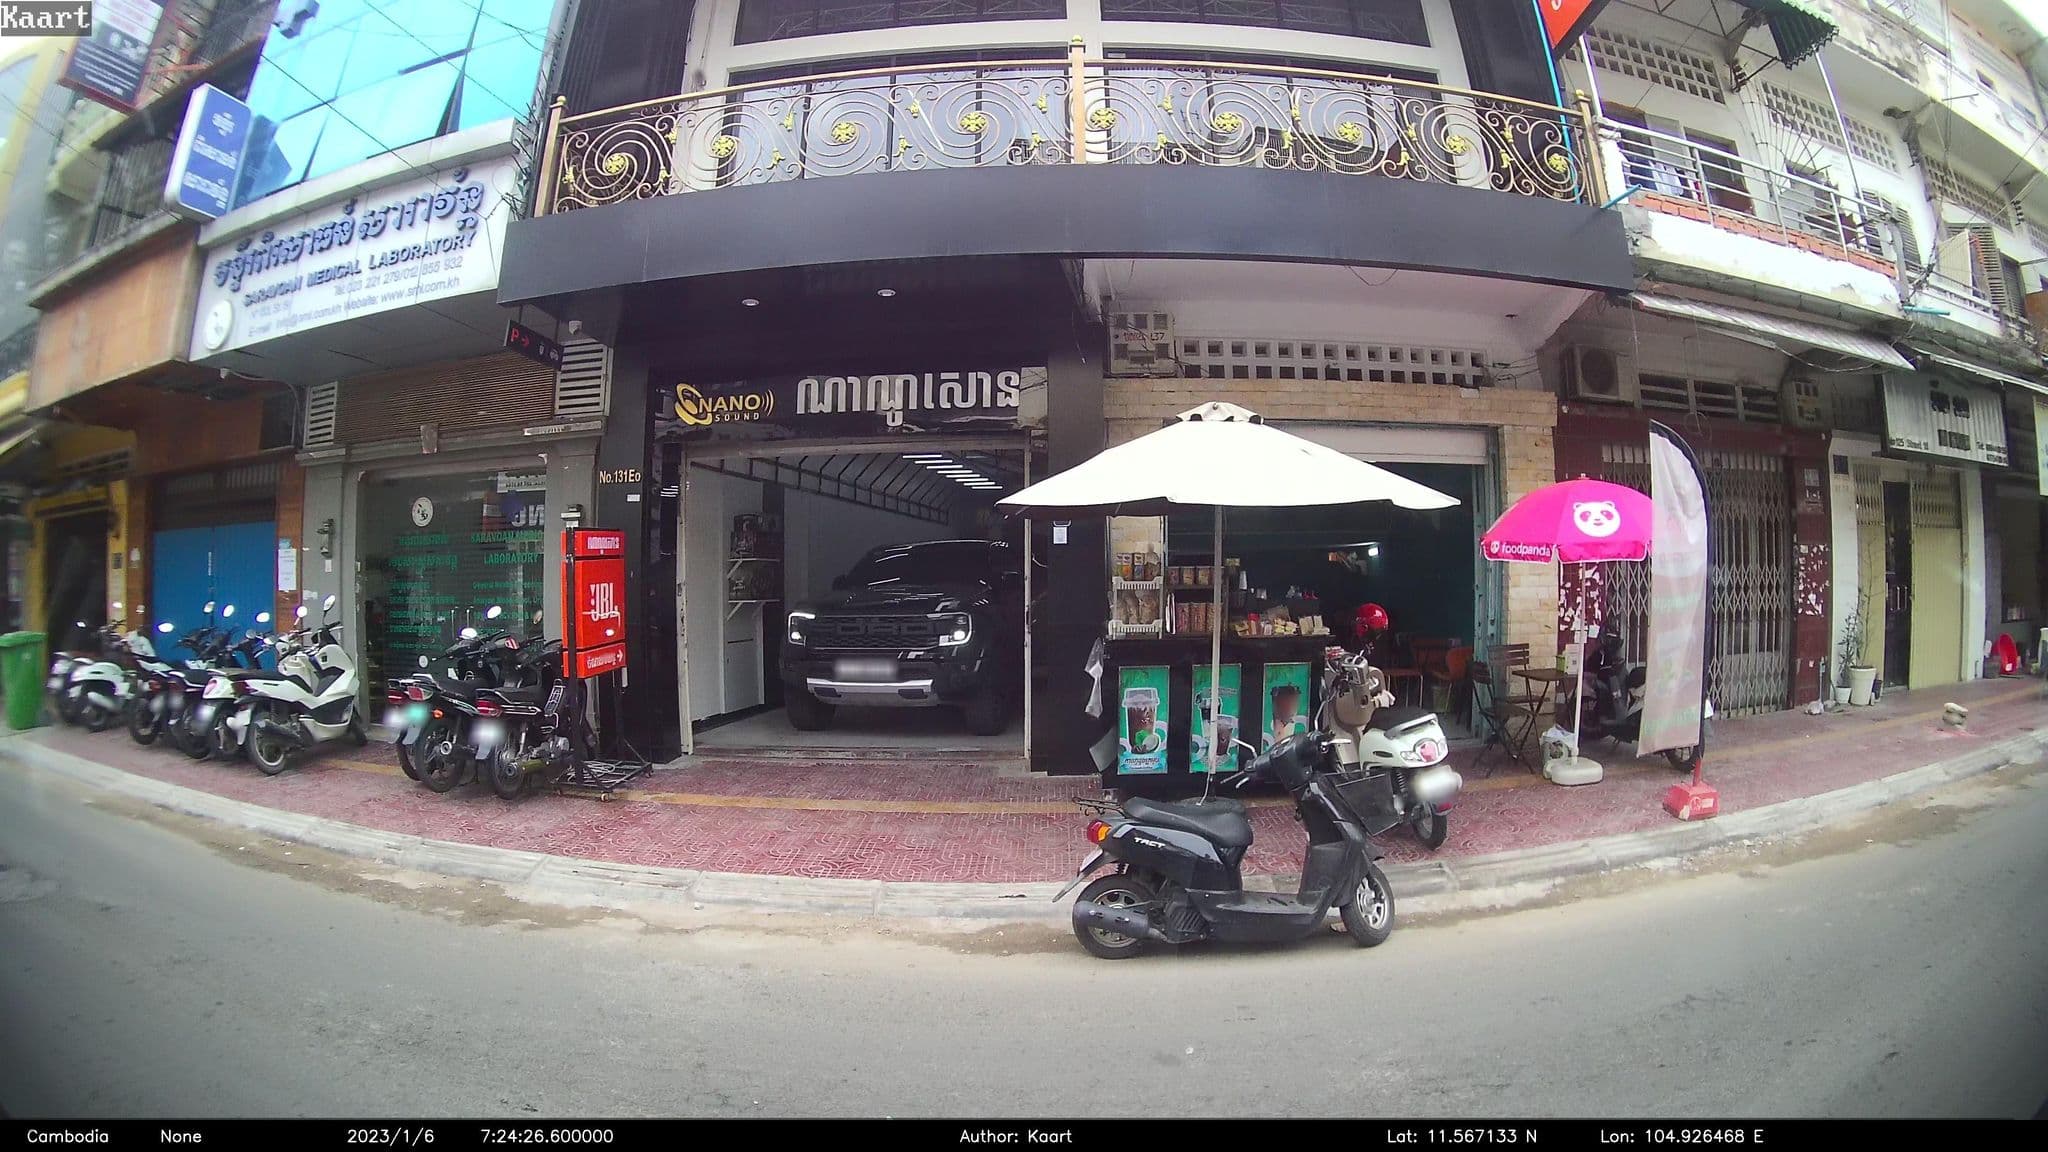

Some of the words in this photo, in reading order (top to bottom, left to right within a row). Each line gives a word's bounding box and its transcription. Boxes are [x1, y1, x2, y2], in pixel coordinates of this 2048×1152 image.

[306, 258, 362, 288] MEDICAL
[368, 230, 477, 270] LABORATORY
[444, 256, 464, 271] 932
[511, 327, 519, 342] P
[699, 394, 761, 413] NANO
[714, 412, 760, 422] SOUND
[599, 469, 641, 485] No.131Eo
[1501, 542, 1551, 557] foodpanda
[484, 551, 539, 565] LABORATORY
[590, 582, 619, 622] JBL
[1133, 836, 1167, 849] TACT
